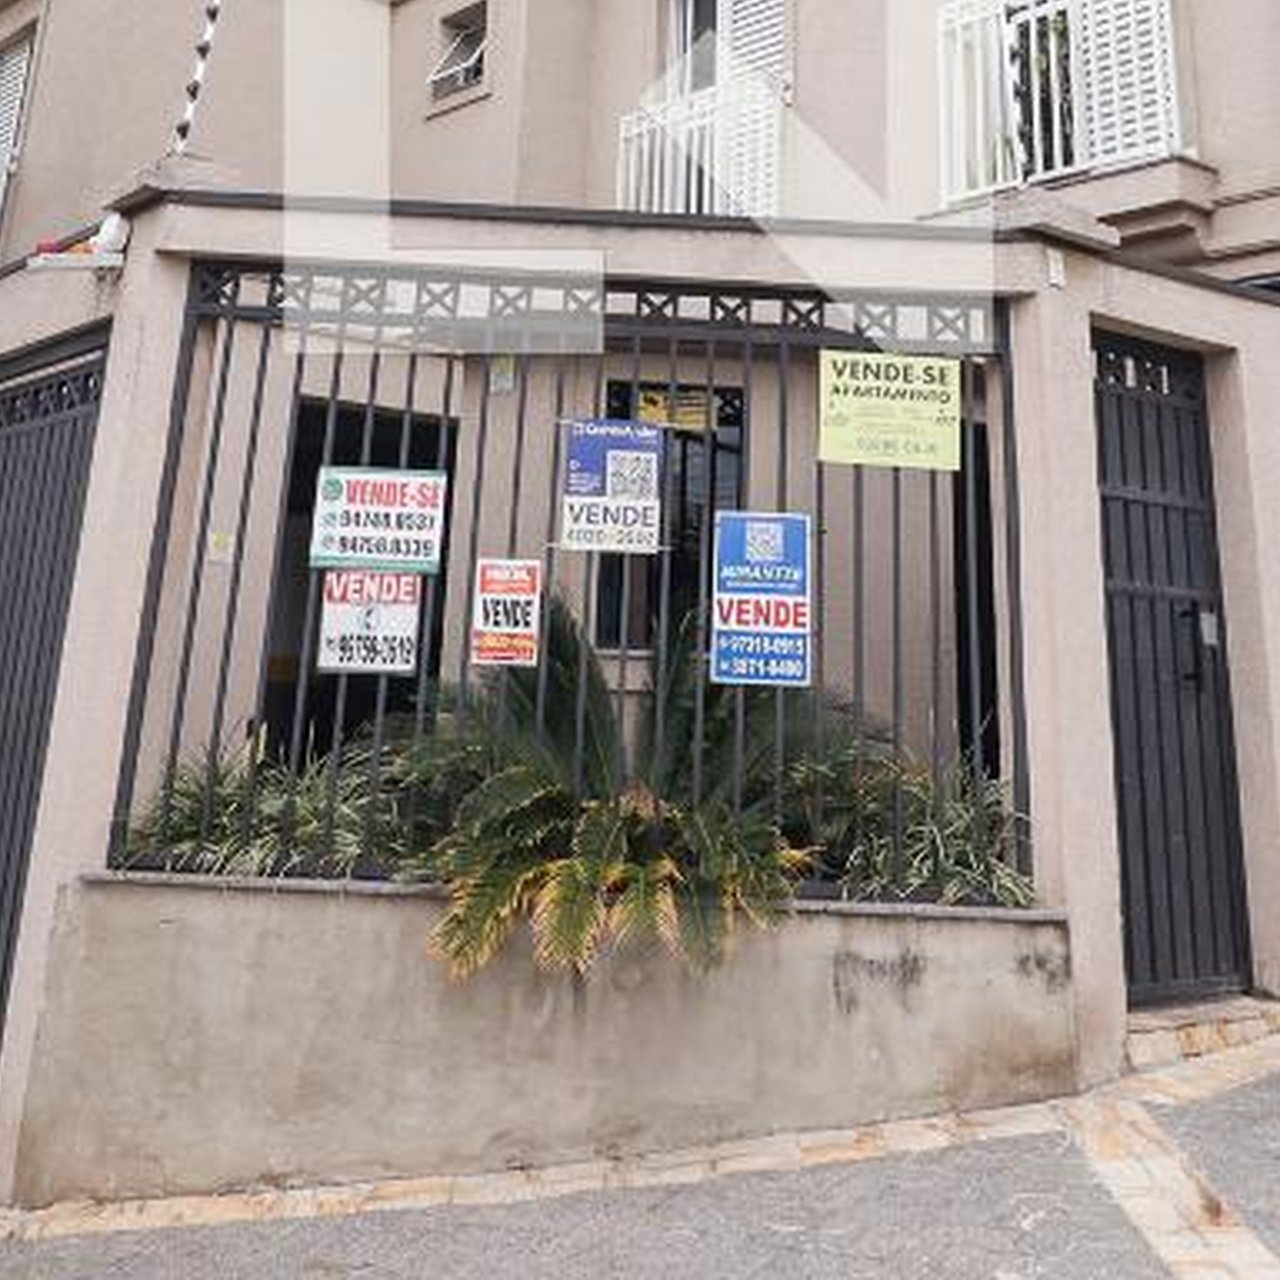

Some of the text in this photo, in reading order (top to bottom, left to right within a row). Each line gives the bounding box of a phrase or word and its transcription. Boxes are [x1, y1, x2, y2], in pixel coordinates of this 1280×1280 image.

[831, 360, 949, 387] VENDE-SE
[345, 479, 440, 508] VENDE-SE
[568, 504, 656, 528] VENDE
[325, 572, 414, 602] VENDE
[481, 597, 534, 628] VENDE
[717, 598, 807, 628] VENDE
